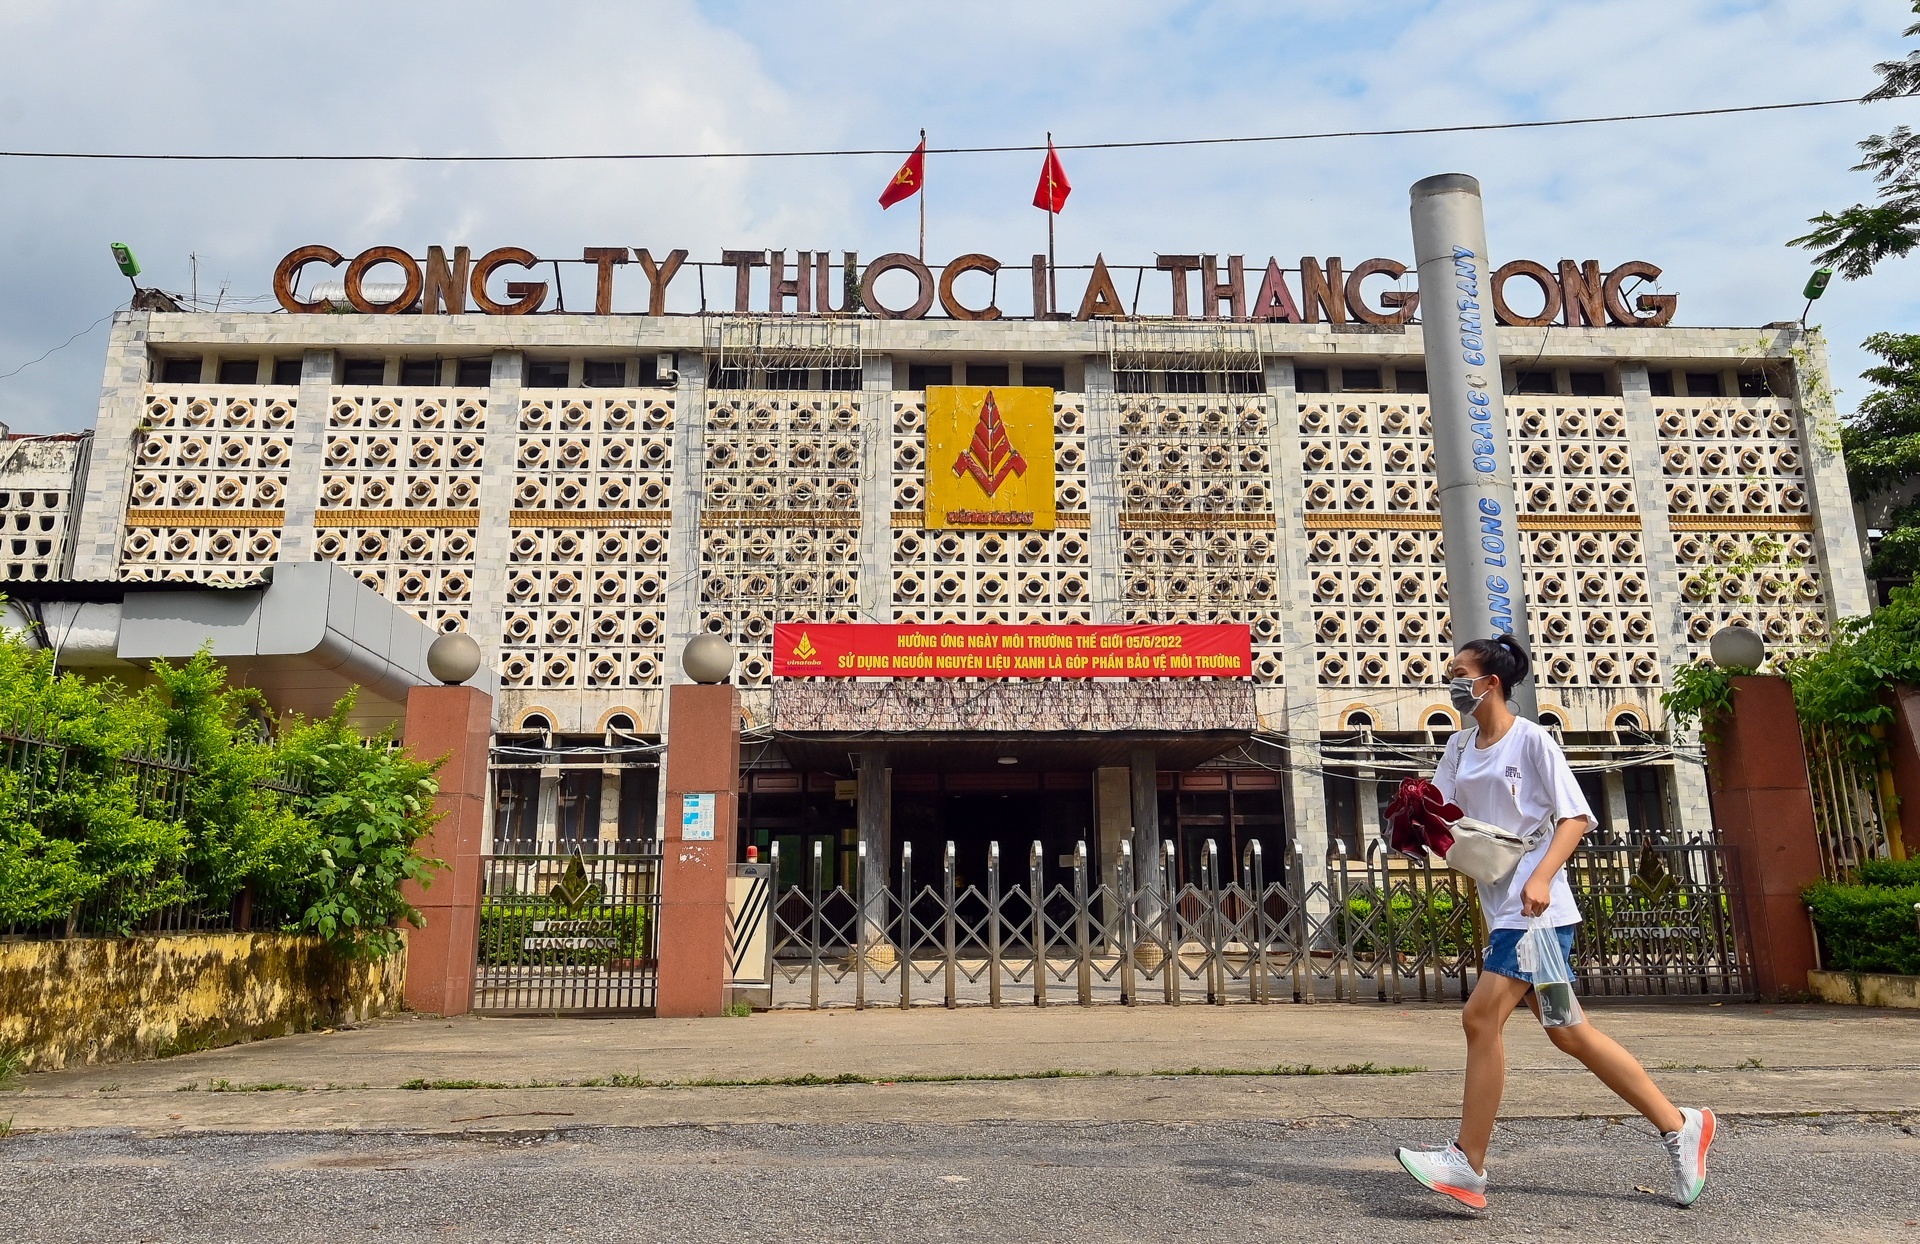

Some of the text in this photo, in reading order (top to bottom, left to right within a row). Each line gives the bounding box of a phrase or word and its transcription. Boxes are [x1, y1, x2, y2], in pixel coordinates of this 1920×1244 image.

[273, 244, 548, 315] CONG
[583, 246, 689, 316] TY
[721, 248, 1003, 320] THUOC
[1156, 253, 1420, 325] THANG
[1489, 258, 1677, 328] ONG
[1452, 245, 1486, 366] COMPANY
[1478, 497, 1507, 568] LONG
[1485, 573, 1514, 645] ANG
[897, 631, 1183, 649] HƯỞNG ỨNG NGÀY MÔI TRƯỜNG THẾ GIỚI 05/6/2022
[837, 651, 856, 669] SỬ
[858, 655, 890, 671] DỤNG
[936, 654, 983, 669] NGUYÊN
[986, 654, 1011, 672] LIỆU
[1014, 656, 1046, 669] XANH
[1049, 653, 1063, 669] LÀ
[1066, 653, 1089, 669] GÓP
[1092, 652, 1124, 669] PHẦN
[1127, 652, 1150, 669] BẢO
[1153, 653, 1167, 672] VỆ
[1169, 653, 1193, 669] MÔI
[1195, 652, 1241, 669] TRƯỜNG
[1505, 770, 1522, 779] DEVIL
[537, 918, 612, 932] inataba
[1663, 927, 1701, 939] LONG
[576, 938, 617, 950] LONG
